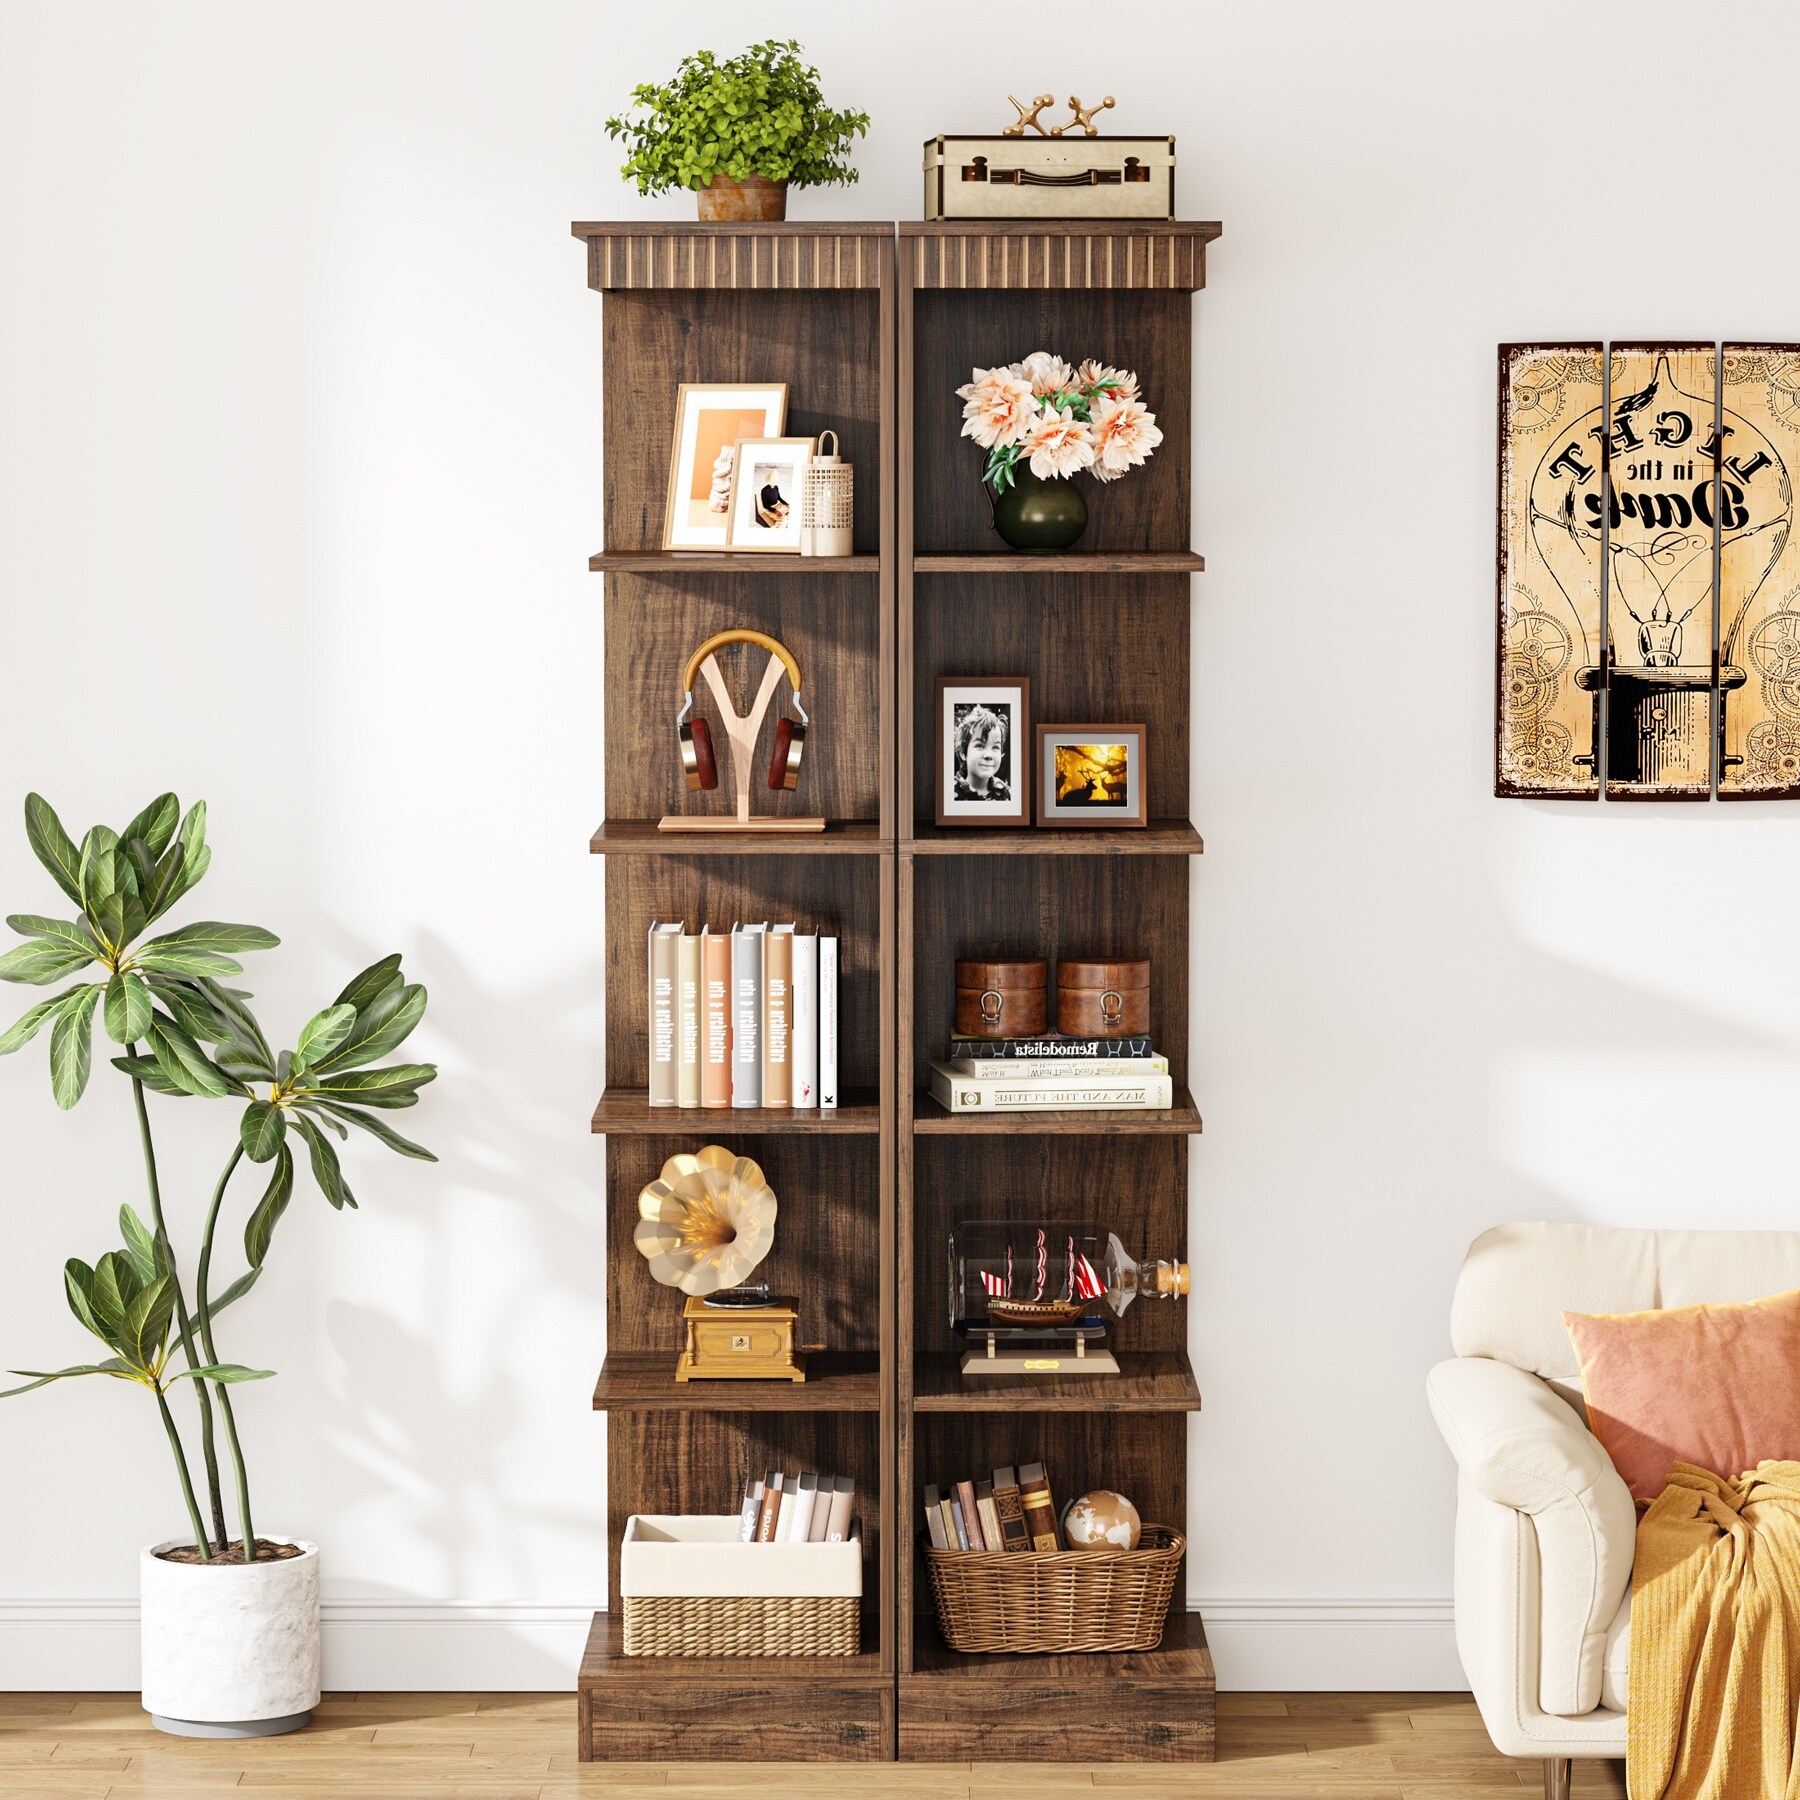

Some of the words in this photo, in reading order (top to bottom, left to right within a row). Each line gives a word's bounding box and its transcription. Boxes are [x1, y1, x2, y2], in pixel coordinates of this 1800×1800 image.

[655, 978, 673, 996] arts
[683, 981, 697, 999] arts
[708, 981, 726, 998] arts
[739, 979, 756, 996] arts
[769, 979, 787, 997] arts
[655, 1009, 674, 1062] architecture
[684, 1012, 698, 1064] architecture
[709, 1011, 727, 1064] architecture
[739, 1010, 757, 1063] architecture
[769, 1010, 788, 1063] architecture
